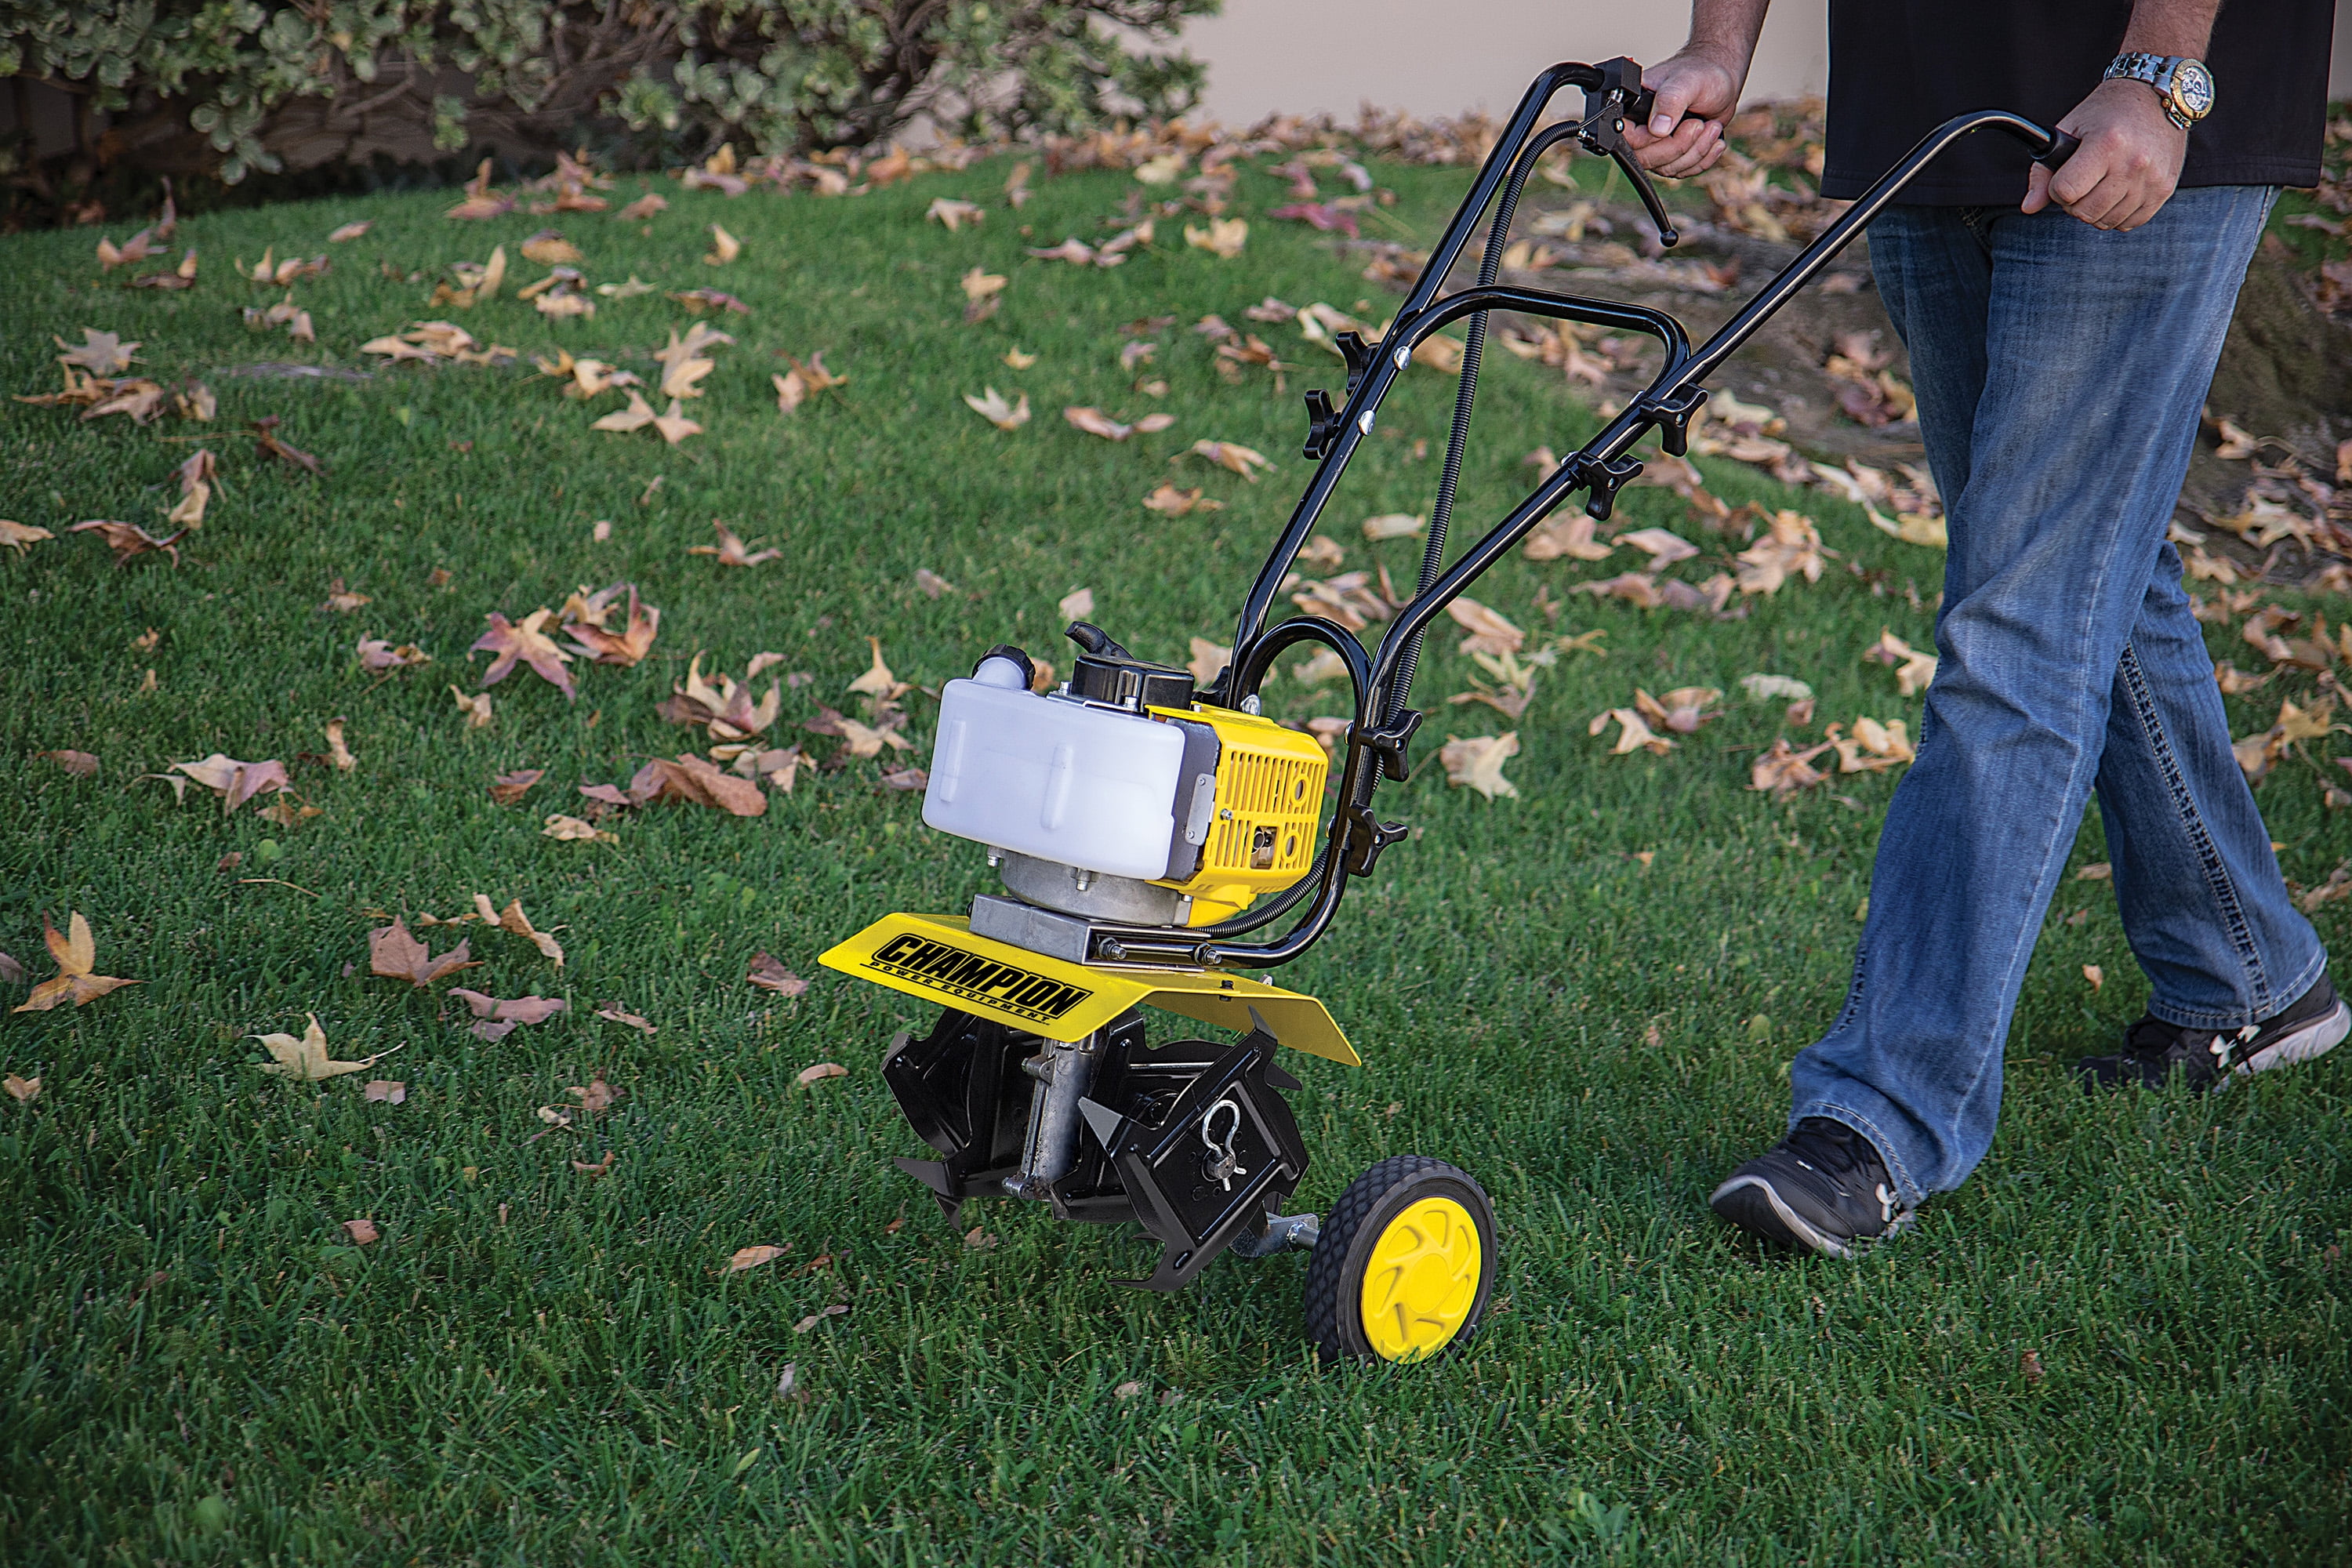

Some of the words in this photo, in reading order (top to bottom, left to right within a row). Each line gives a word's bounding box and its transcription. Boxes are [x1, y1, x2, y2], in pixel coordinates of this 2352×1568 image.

[869, 961, 934, 985] POWER
[940, 984, 1051, 1021] EQUIPMENT
[876, 935, 1088, 1016] CHAMPION
